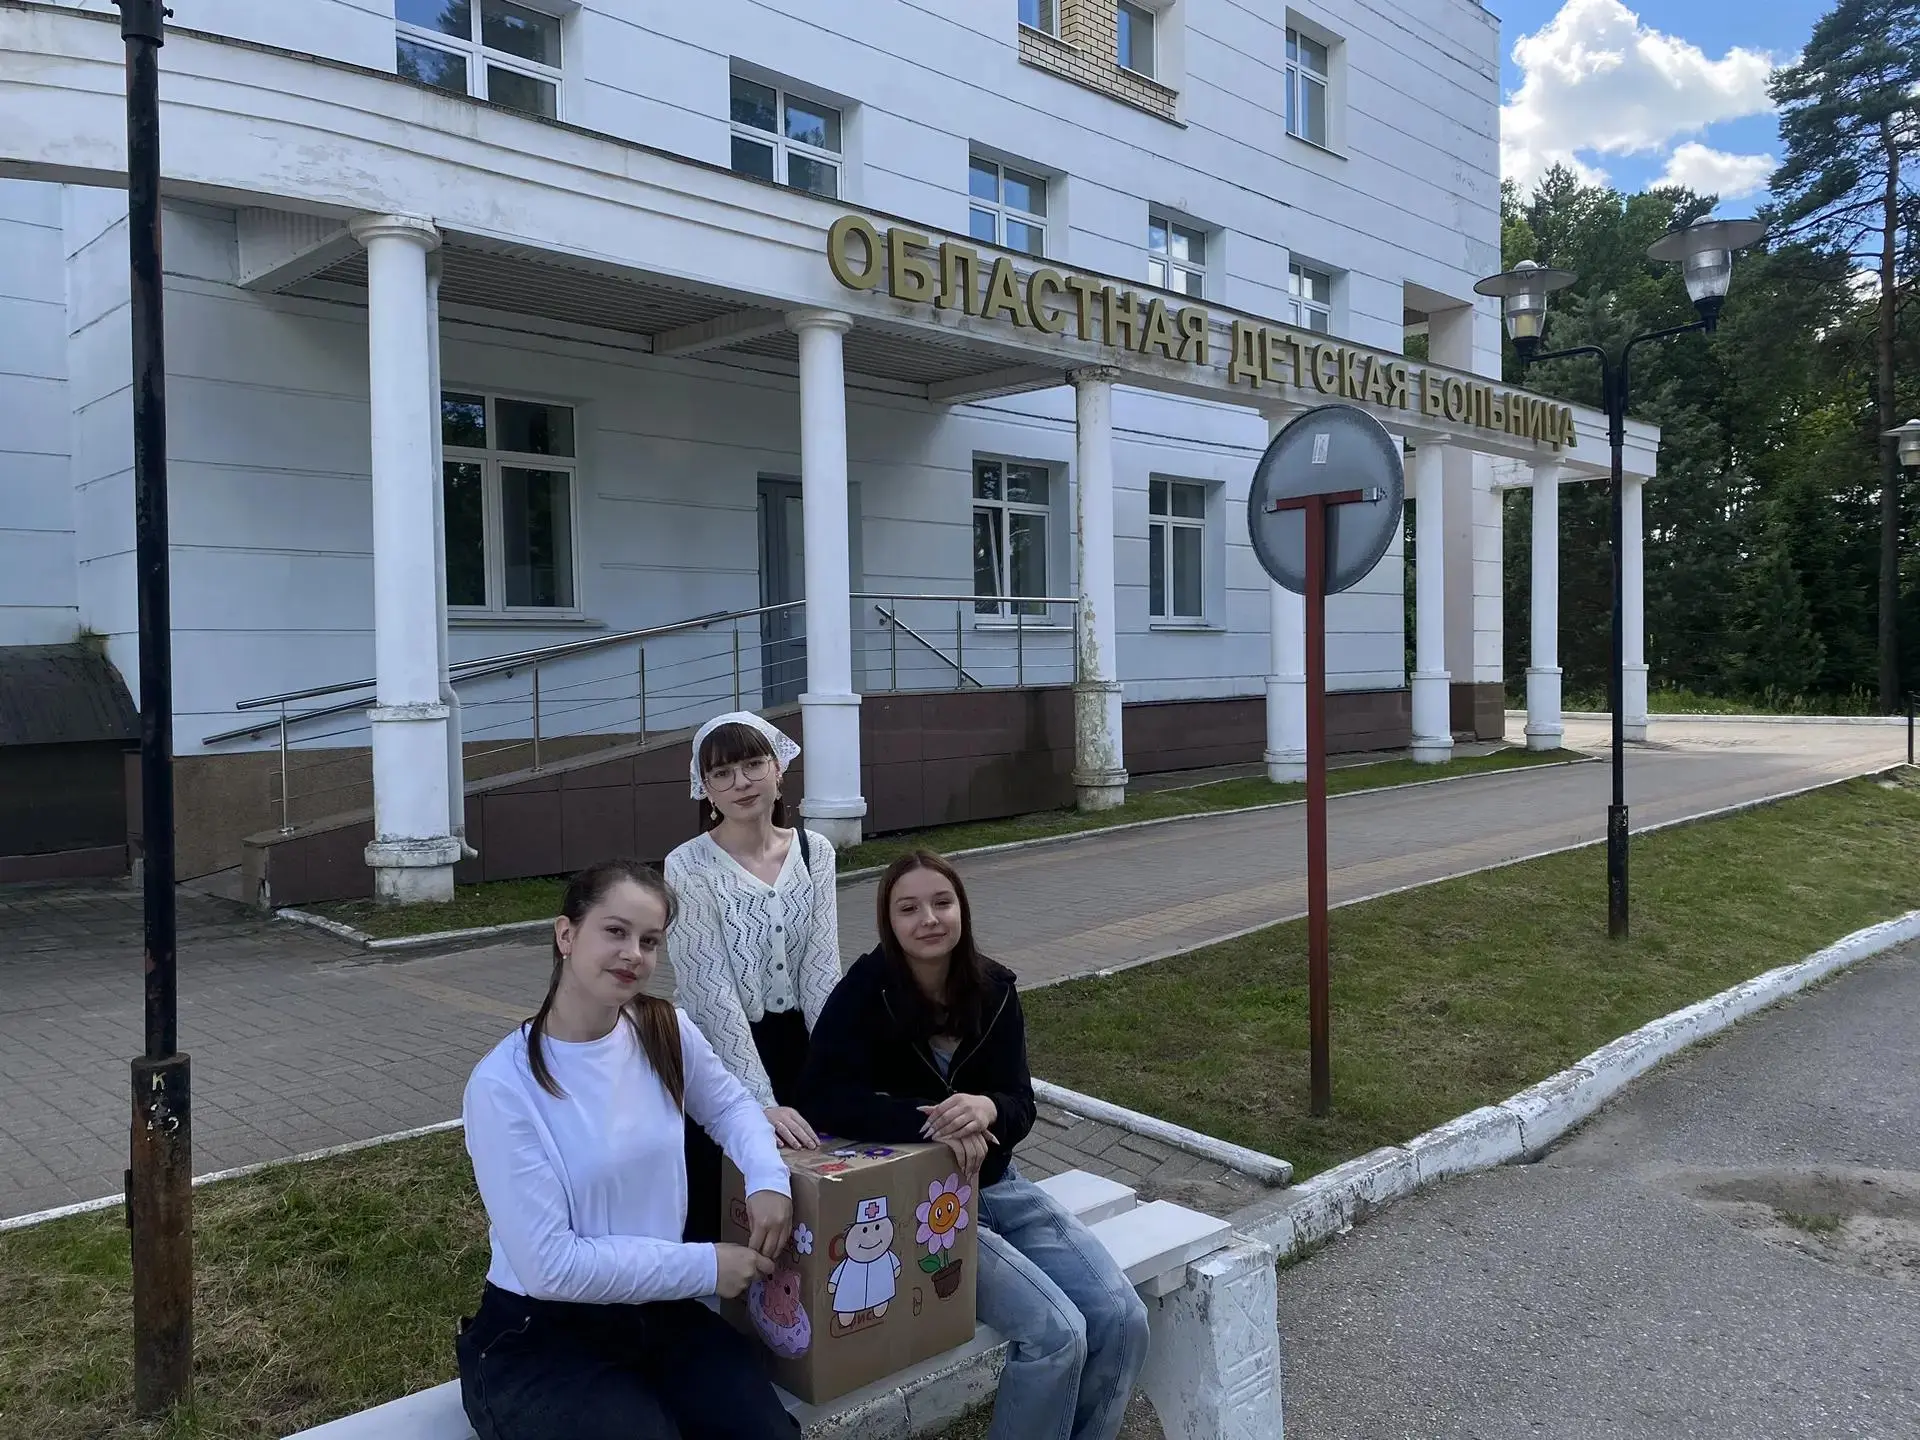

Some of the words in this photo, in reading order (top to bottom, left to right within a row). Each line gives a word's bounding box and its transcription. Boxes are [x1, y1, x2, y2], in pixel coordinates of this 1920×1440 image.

[827, 215, 1209, 365] ОБЛАСТНАЯ
[1228, 320, 1409, 410] ДЕТСКАЯ
[1421, 369, 1577, 451] БОЛЬНИЦА
